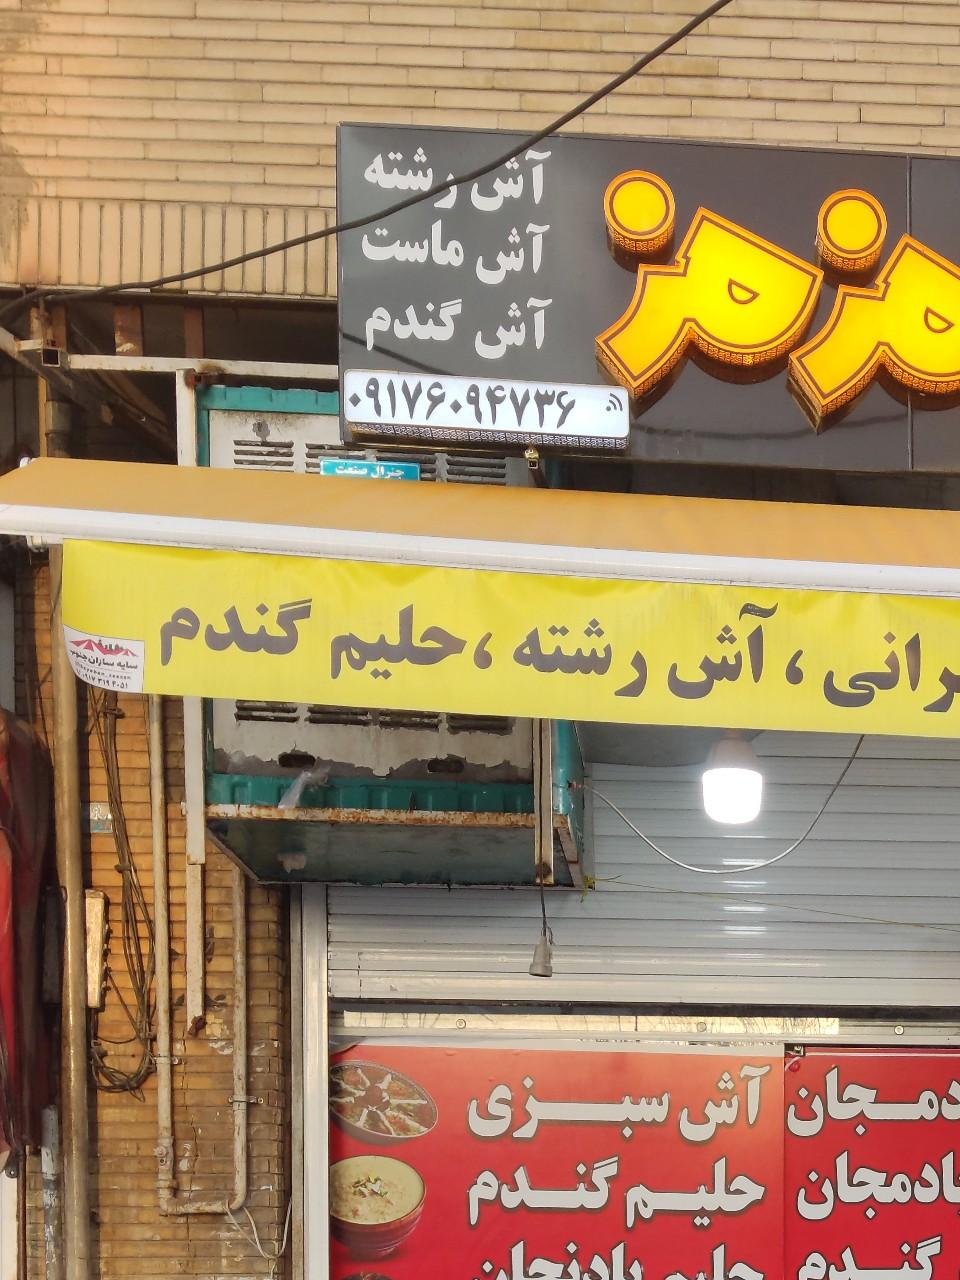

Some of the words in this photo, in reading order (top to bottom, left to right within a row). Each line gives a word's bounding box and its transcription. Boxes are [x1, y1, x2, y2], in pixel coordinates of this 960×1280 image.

[364, 146, 458, 210] رشته
[470, 148, 552, 213] آش
[361, 219, 465, 267] ماست
[475, 222, 552, 285] آش
[364, 298, 463, 351] گندم
[474, 297, 553, 359] آش
[348, 376, 577, 430] ۰۹۱۷۶۰۹۴۷۳۶
[158, 597, 314, 667] گندم
[512, 616, 649, 699] رشته
[666, 602, 780, 700] آش
[467, 1078, 671, 1139] سبزی
[679, 1065, 772, 1142] آش
[467, 1158, 620, 1227] گندم
[625, 1158, 767, 1227] حلیم
